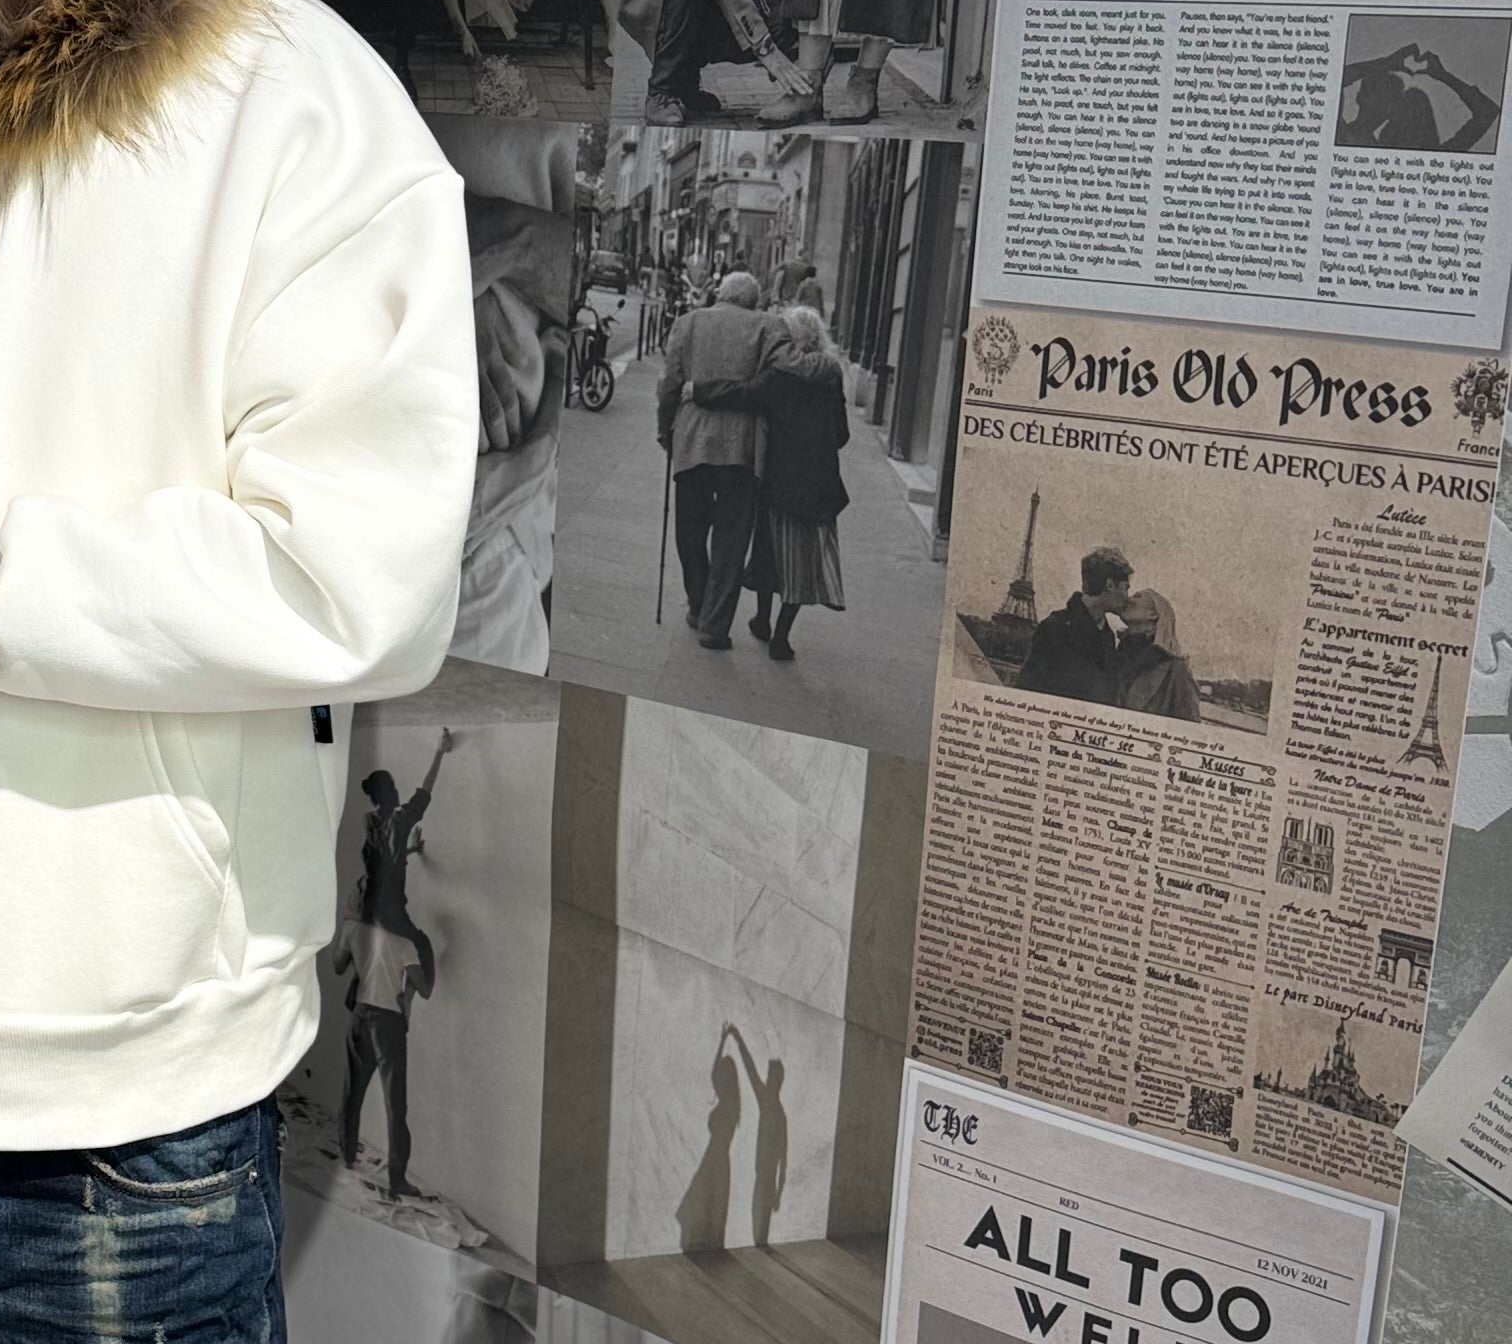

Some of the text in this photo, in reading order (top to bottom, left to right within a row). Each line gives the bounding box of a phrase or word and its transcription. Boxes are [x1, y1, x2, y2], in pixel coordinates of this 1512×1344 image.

[1031, 336, 1433, 428] Paris Old Press
[964, 414, 1004, 439] DES
[1010, 420, 1144, 457] CÉLÉBRITÉS
[1148, 438, 1200, 465] ONT
[1205, 440, 1249, 471] ÉTÉ
[1253, 452, 1387, 490] APERÇUES
[1391, 463, 1410, 492] À
[964, 1205, 1271, 1344] ALL TOO
